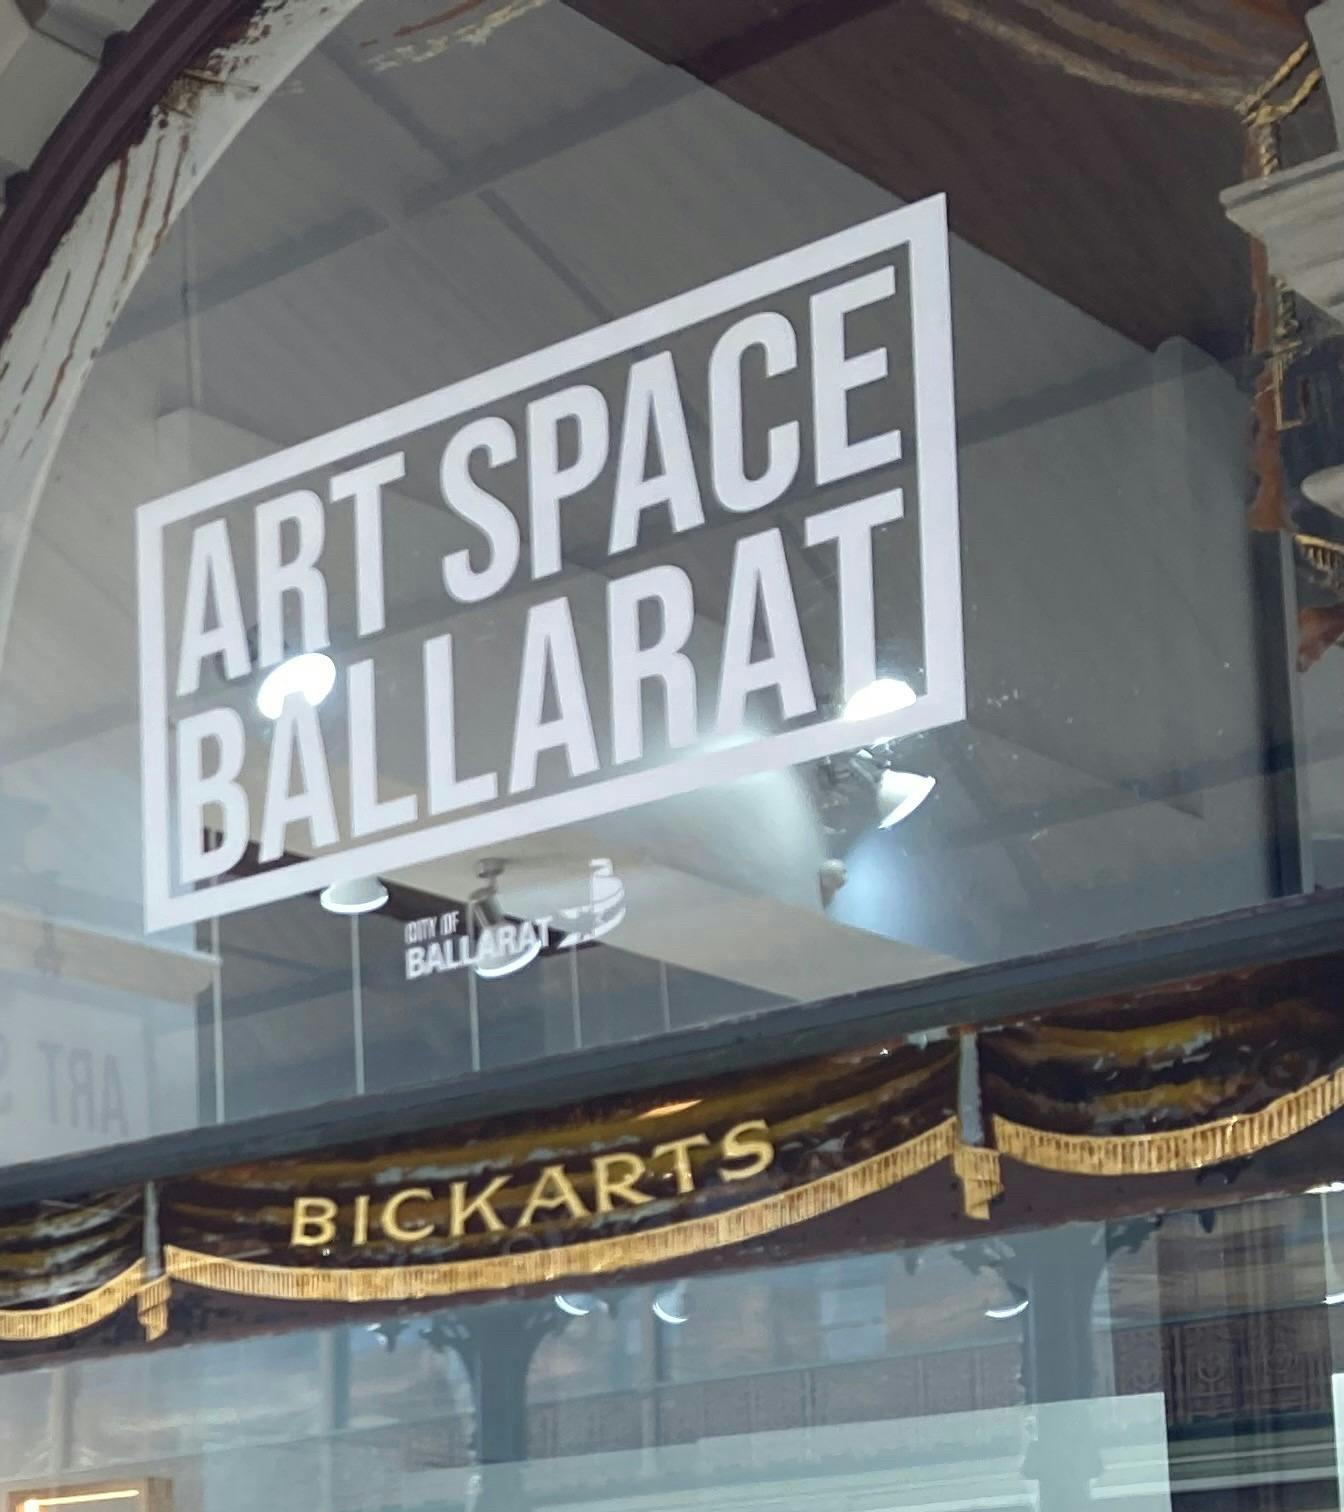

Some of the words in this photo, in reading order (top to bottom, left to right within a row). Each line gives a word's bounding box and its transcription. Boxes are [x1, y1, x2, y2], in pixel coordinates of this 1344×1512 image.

[176, 451, 405, 696] ART
[441, 264, 902, 602] SPACE
[175, 488, 904, 884] BALLARAT
[404, 916, 437, 944] CITY
[404, 915, 554, 981] BALLARAT
[289, 1119, 776, 1248] BICKARTS
